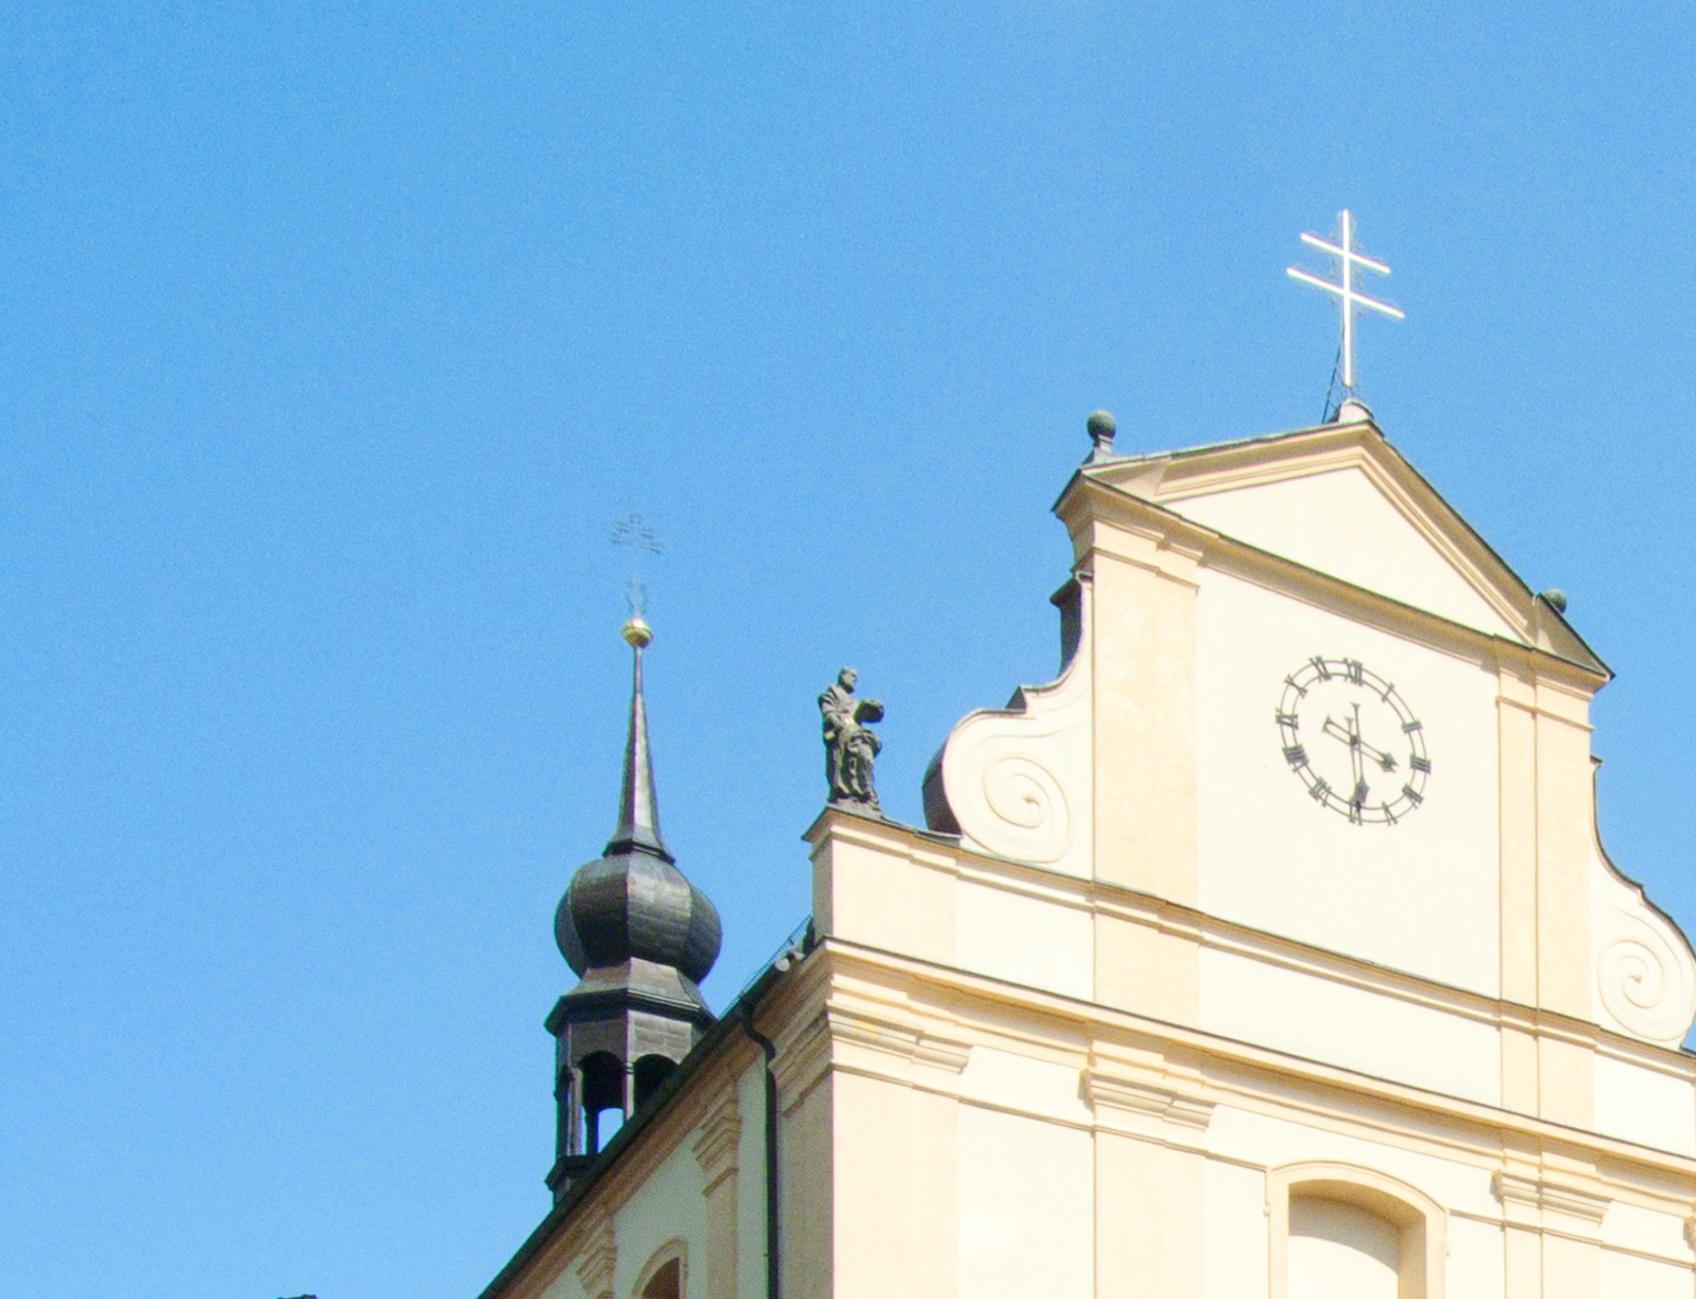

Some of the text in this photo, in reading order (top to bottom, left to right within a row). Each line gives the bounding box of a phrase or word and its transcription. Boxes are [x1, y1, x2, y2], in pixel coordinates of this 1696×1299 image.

[1309, 656, 1331, 683] XI
[1343, 658, 1363, 686] XII
[1284, 673, 1307, 699] X
[1275, 707, 1299, 730] IX
[1402, 719, 1423, 734] II
[1282, 744, 1309, 774] VIII
[1410, 754, 1432, 776] III
[1381, 801, 1399, 827] V
